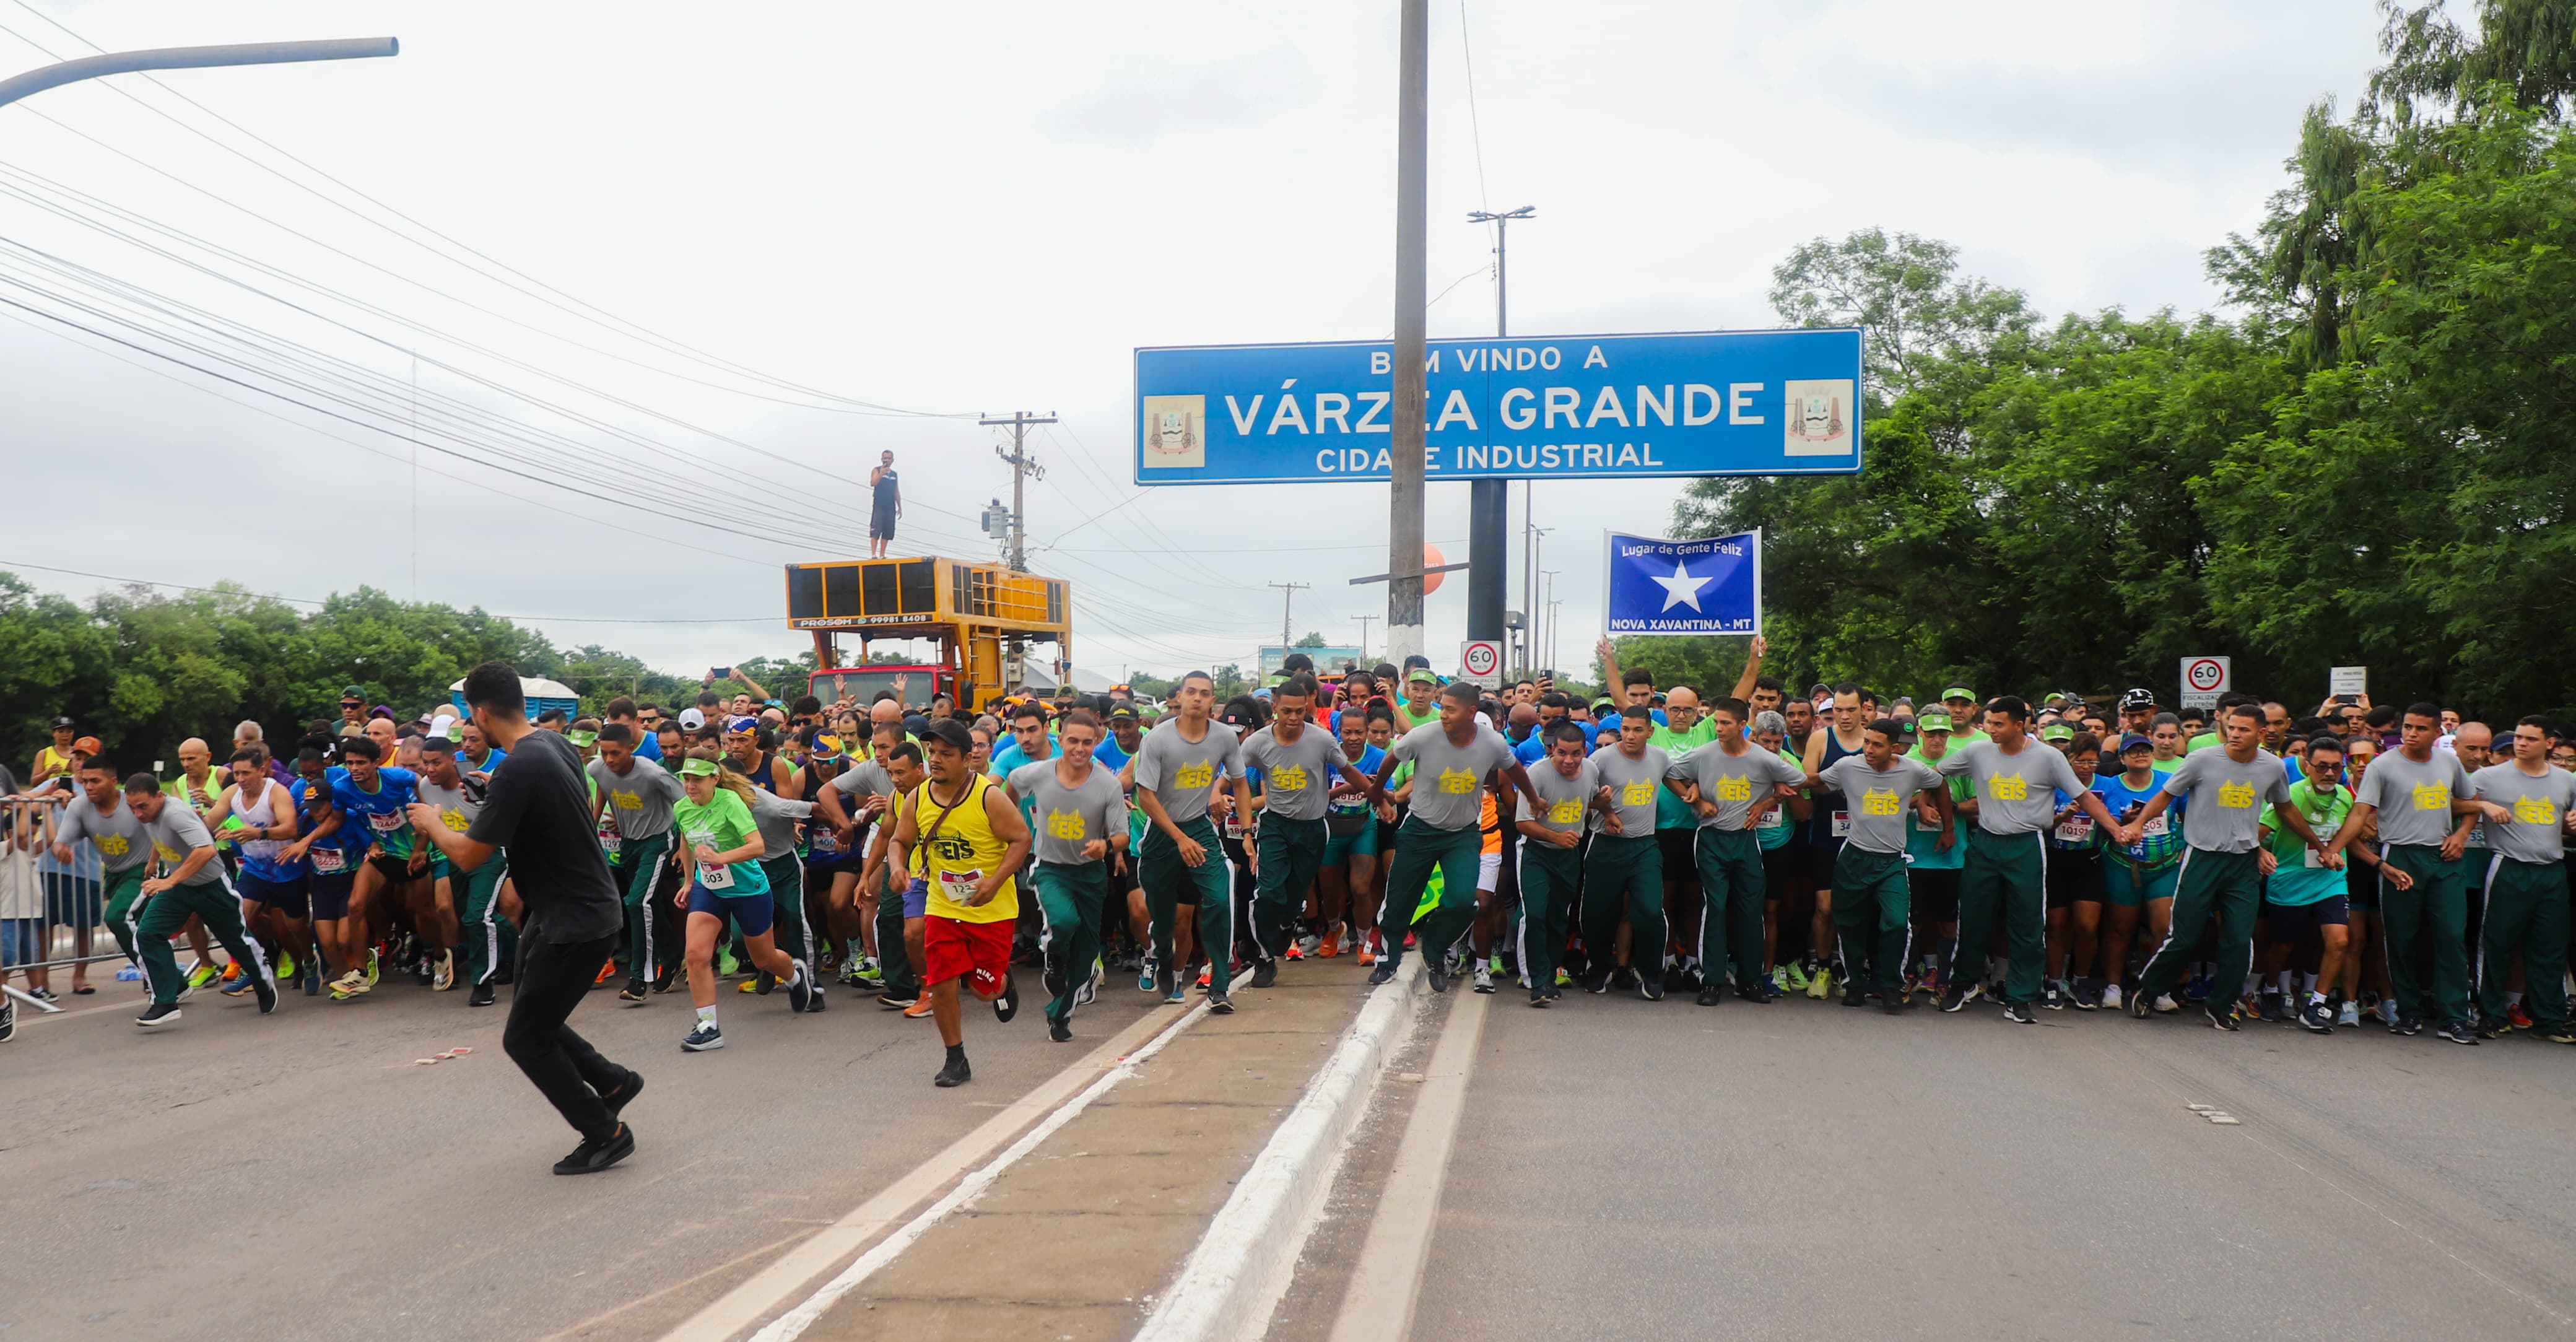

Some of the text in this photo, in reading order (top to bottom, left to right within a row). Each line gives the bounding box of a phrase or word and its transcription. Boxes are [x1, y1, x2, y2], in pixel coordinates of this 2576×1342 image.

[1371, 345, 1609, 375] BM VINDO A
[1224, 378, 1764, 436] VÁRZA GRANDE
[1316, 442, 1664, 473] CIDAE INDUSTRIAL
[1622, 542, 1743, 557] Lugar de Gente Feliz
[800, 619, 852, 627] PROSOM
[902, 614, 926, 622] 8408
[1611, 619, 1647, 630] NOVA
[1649, 619, 1723, 630] XAVANTINA
[1733, 618, 1752, 630] MT
[1470, 651, 1491, 662] 60
[2194, 666, 2217, 678] 60
[977, 968, 996, 983] NIKE
